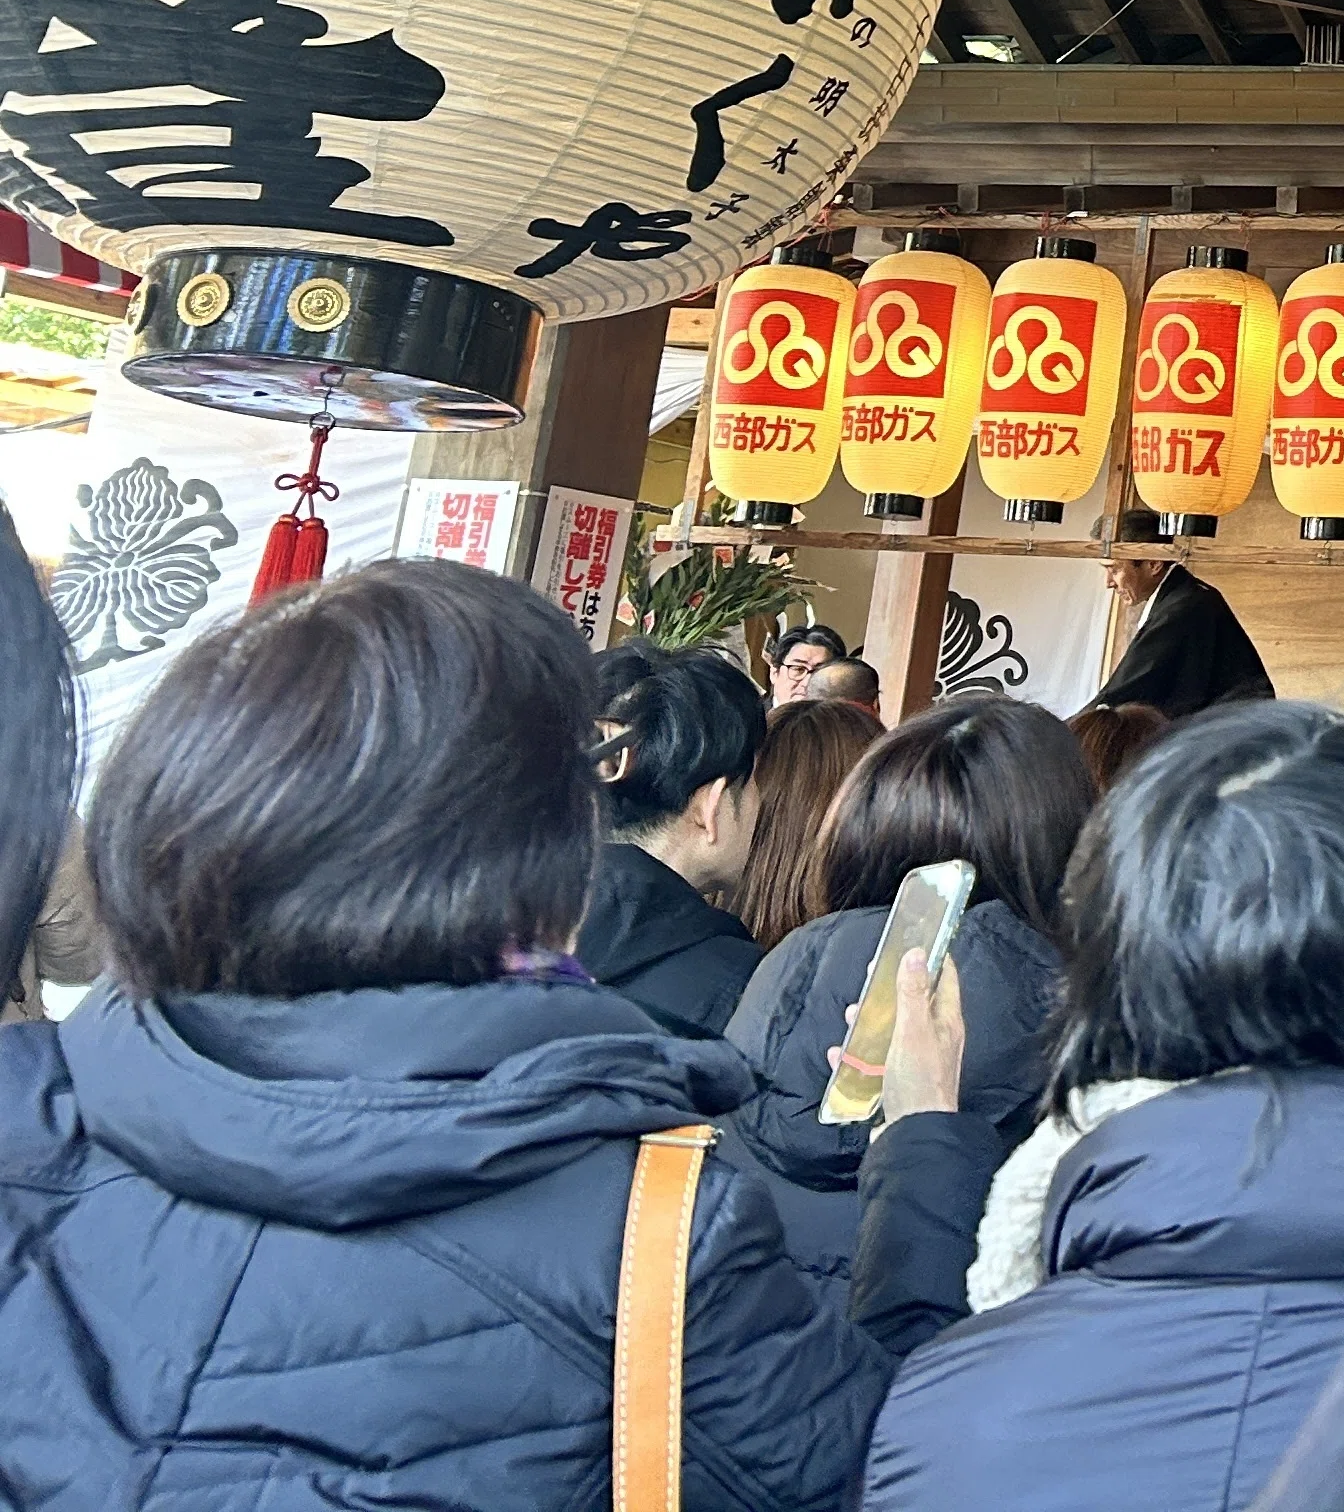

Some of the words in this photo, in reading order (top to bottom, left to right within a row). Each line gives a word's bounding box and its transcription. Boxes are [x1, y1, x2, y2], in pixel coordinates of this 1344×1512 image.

[713, 411, 817, 454] 西部ガス
[841, 402, 937, 444] 西部ガス
[980, 418, 1081, 460] 西部ガス
